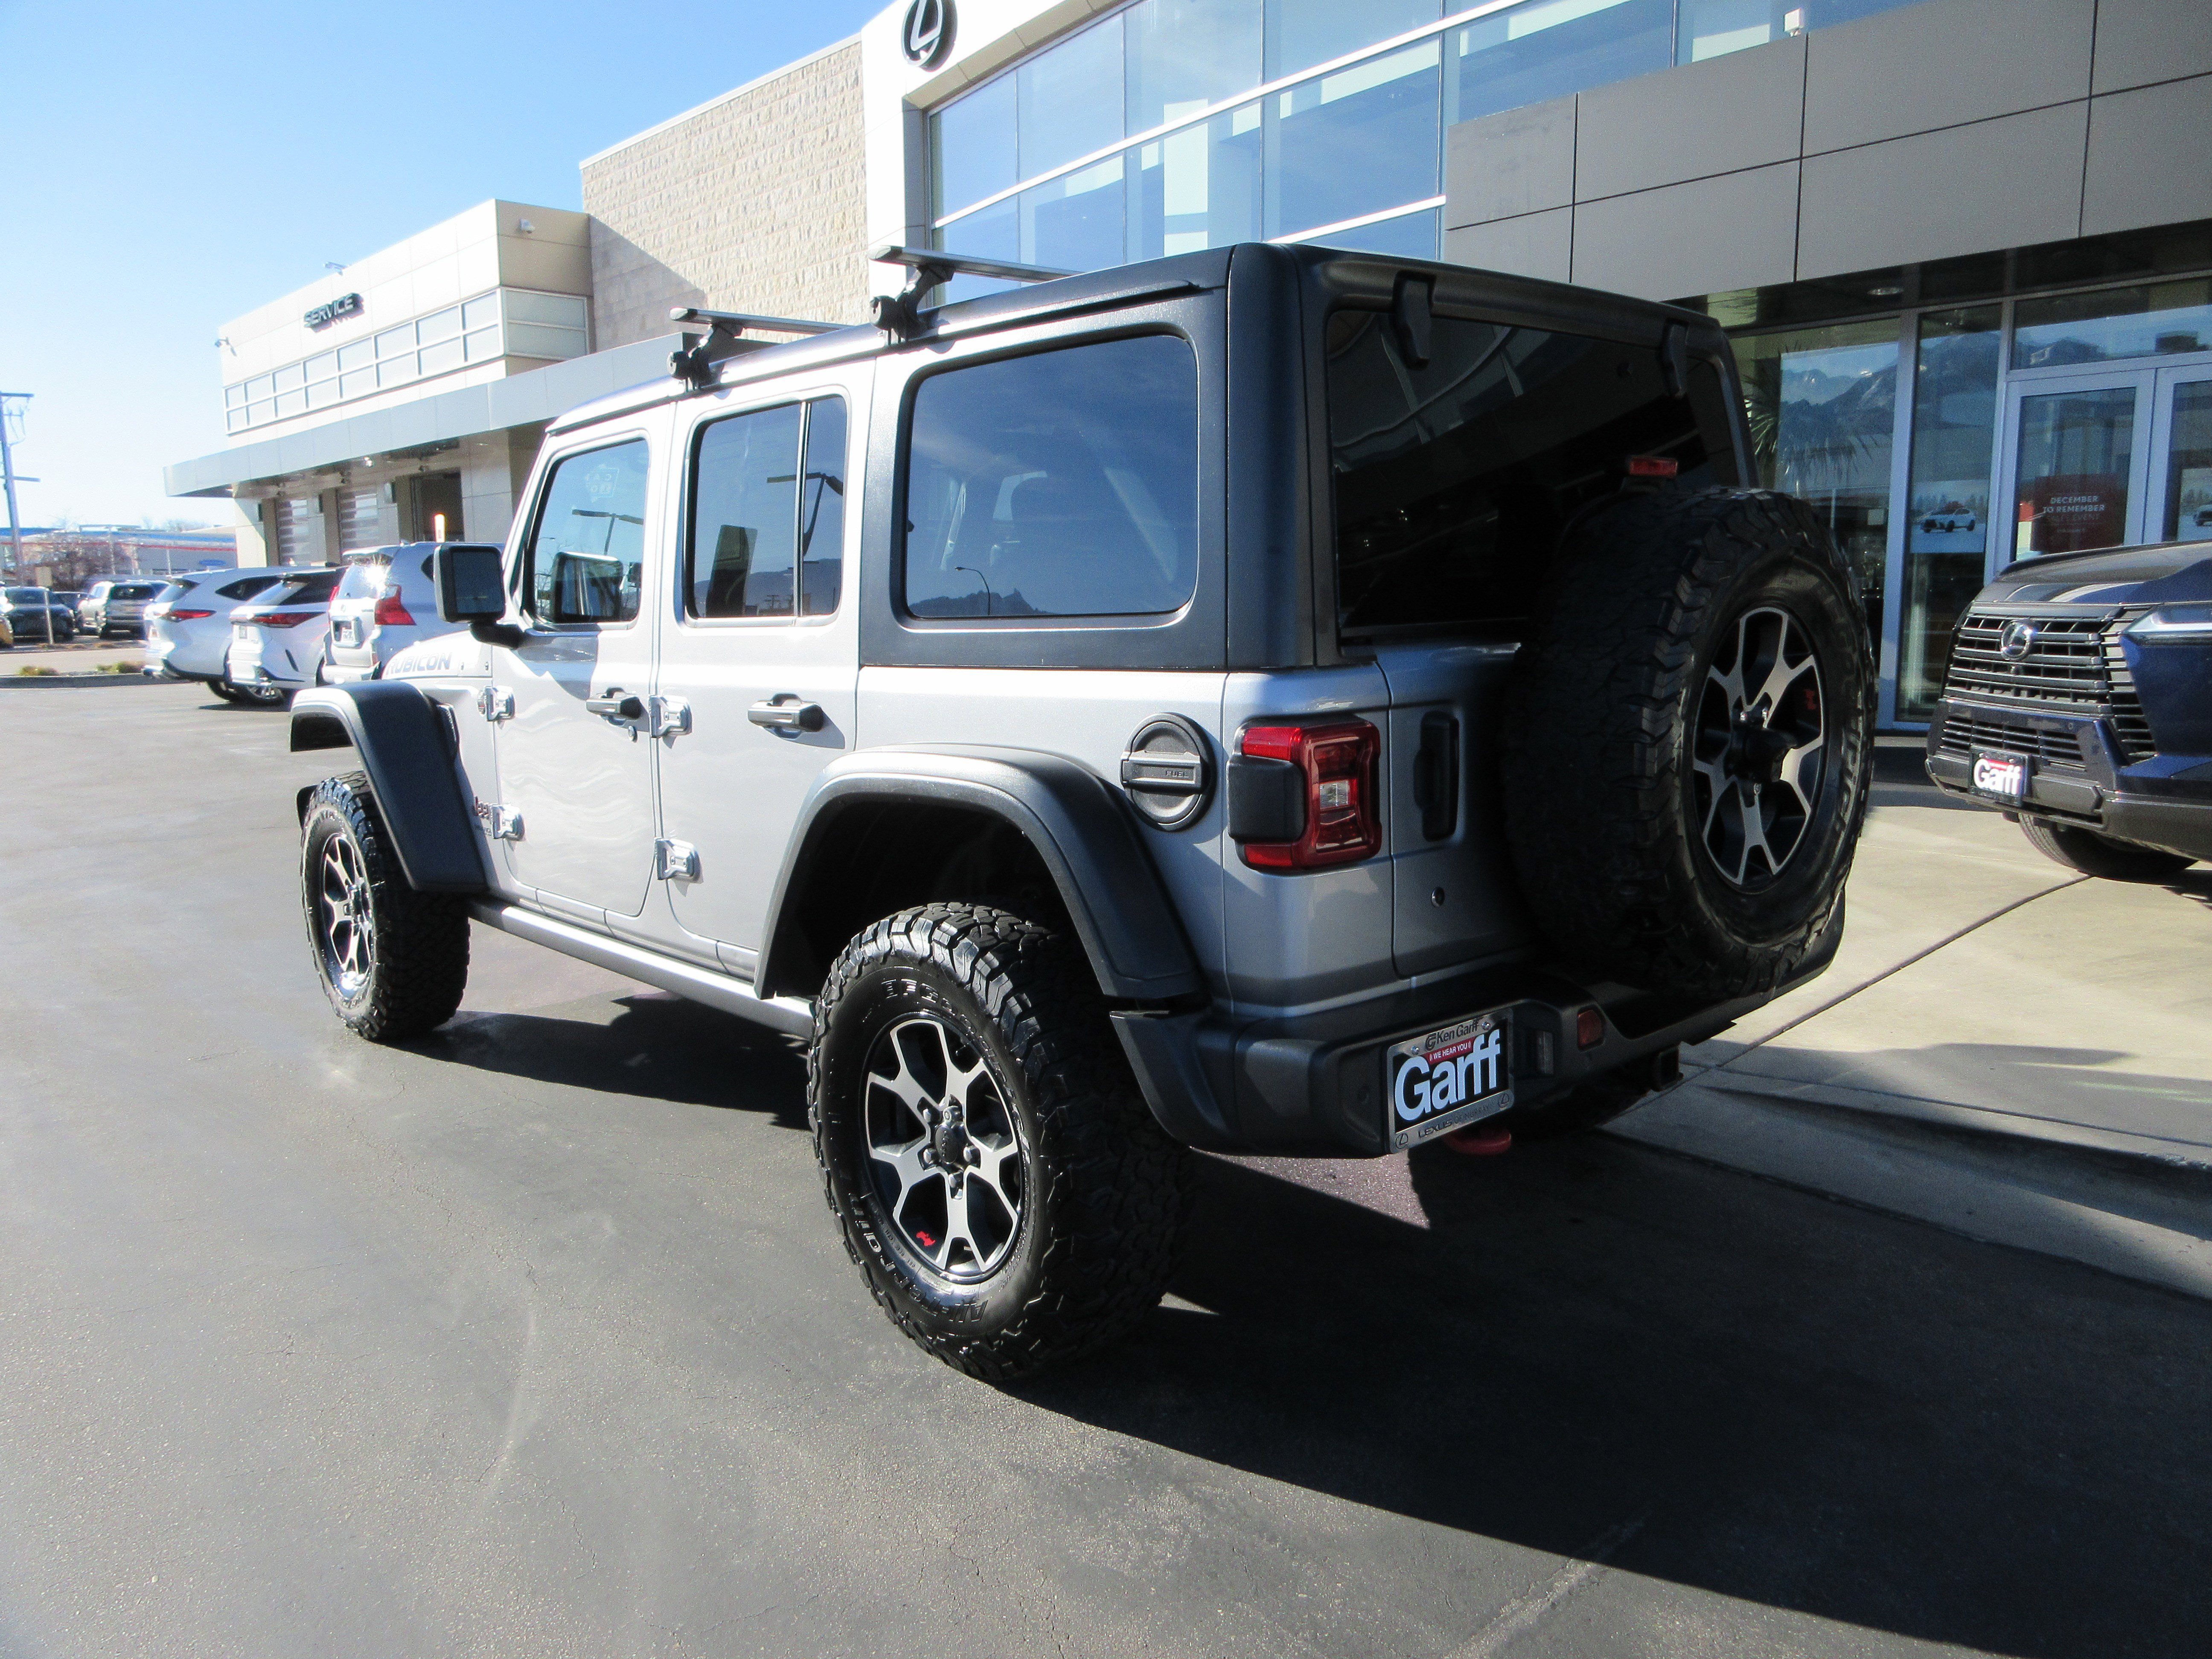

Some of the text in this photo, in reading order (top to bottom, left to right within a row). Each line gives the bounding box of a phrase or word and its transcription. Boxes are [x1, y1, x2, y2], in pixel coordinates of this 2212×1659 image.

[303, 293, 362, 327] SERVICE
[2050, 495, 2099, 504] DECEMBER
[2056, 504, 2106, 512] REMEMBER
[385, 652, 453, 675] RUBICON
[1974, 759, 2021, 795] Garff
[1437, 1019, 1479, 1044] Ken Garff
[1433, 1051, 1442, 1059] WE
[1442, 1046, 1456, 1057] HEAR
[1394, 1029, 1501, 1121] Garff
[1418, 1119, 1452, 1138] LEXUS
